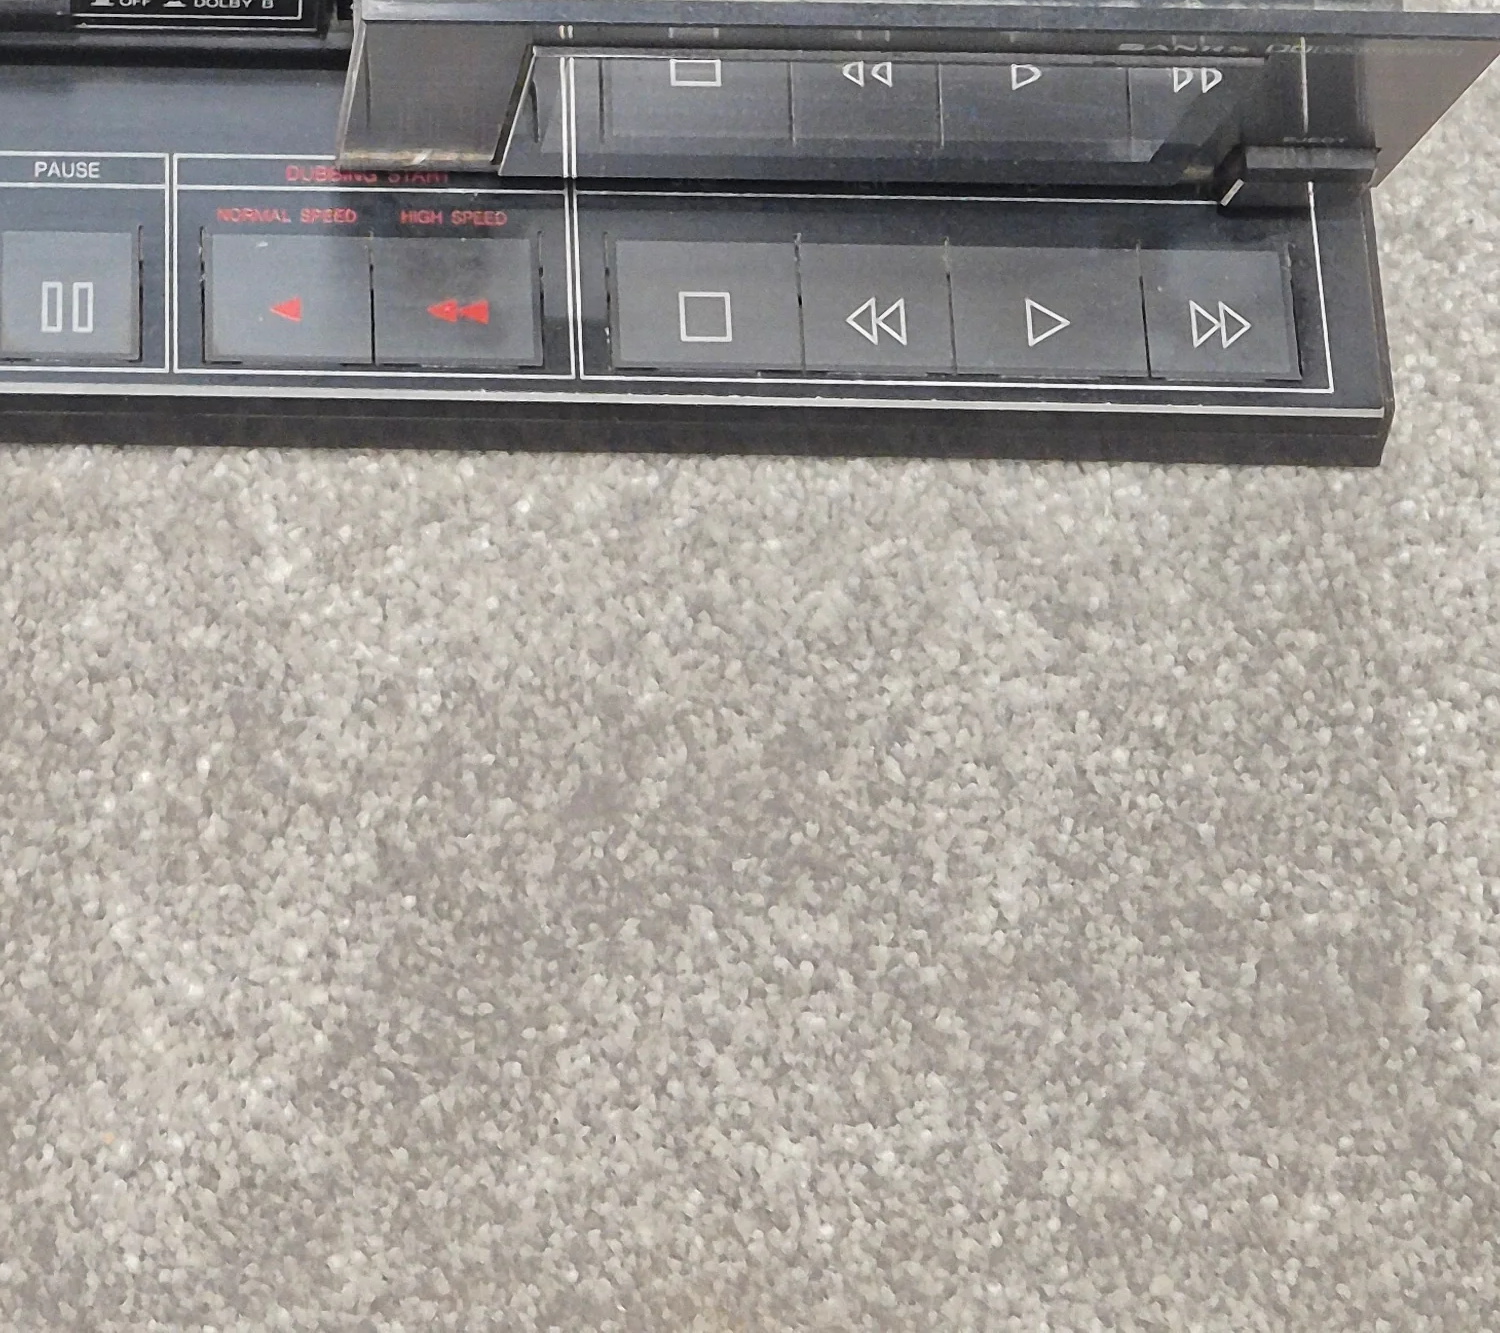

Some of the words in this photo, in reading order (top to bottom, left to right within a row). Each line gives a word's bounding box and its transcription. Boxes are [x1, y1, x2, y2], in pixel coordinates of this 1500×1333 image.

[33, 160, 101, 179] PAUSE
[285, 164, 377, 184] DUBBING
[215, 207, 292, 224] NORMAL
[300, 208, 358, 225] SPEED
[400, 209, 444, 226] HIGH
[450, 210, 508, 227] SPEED
